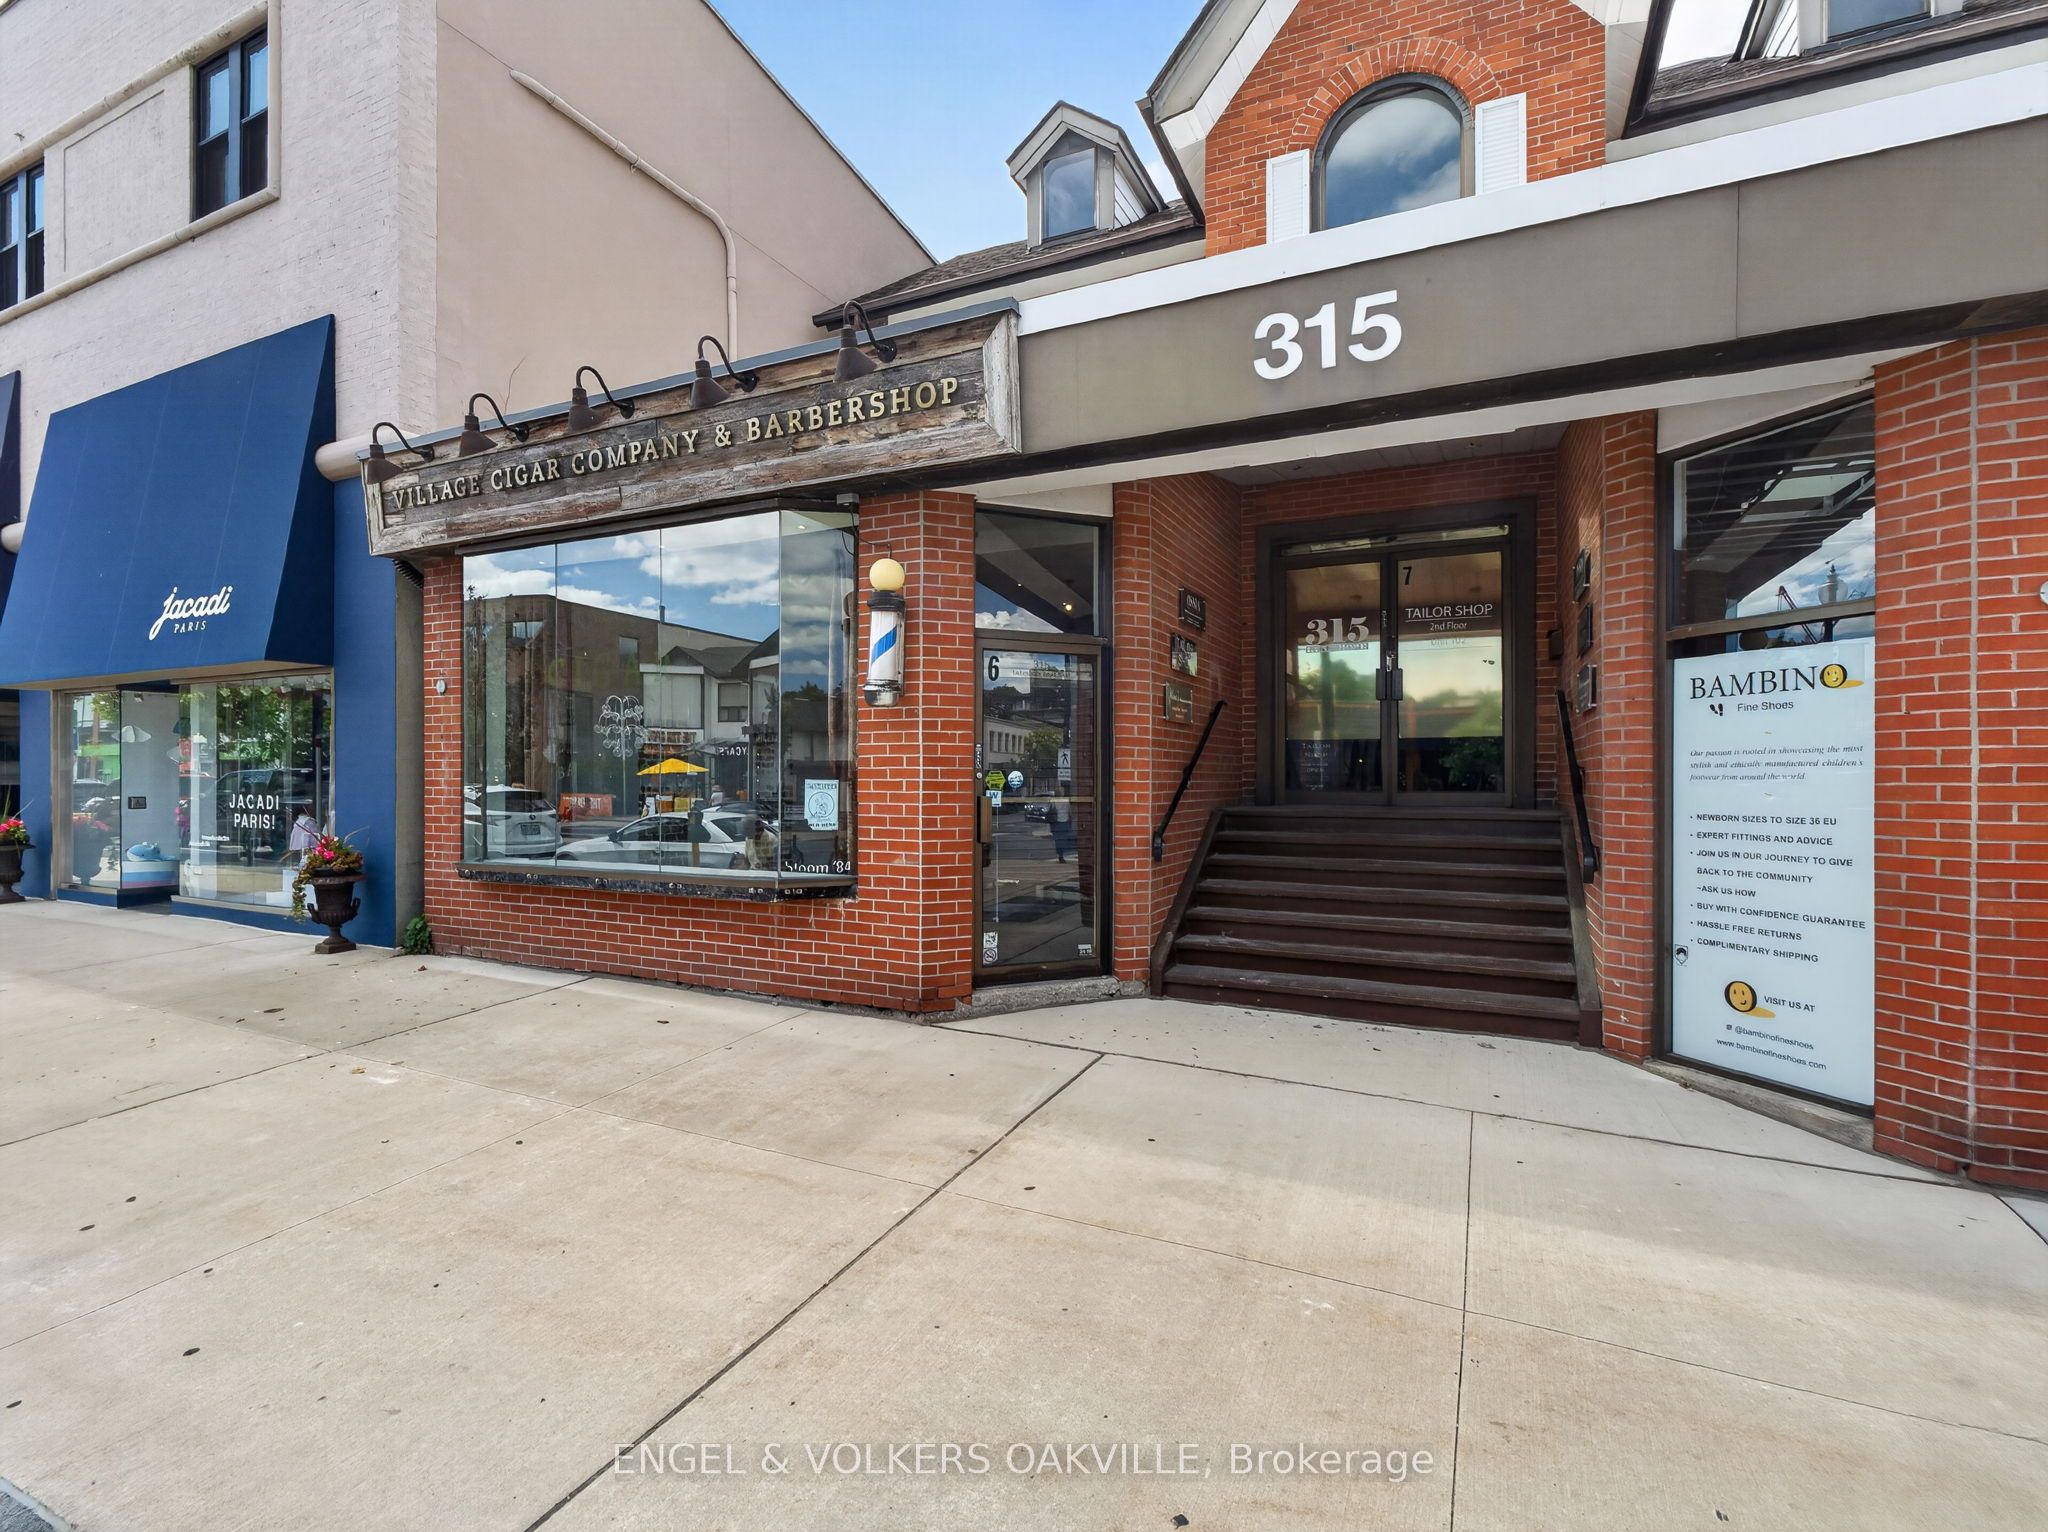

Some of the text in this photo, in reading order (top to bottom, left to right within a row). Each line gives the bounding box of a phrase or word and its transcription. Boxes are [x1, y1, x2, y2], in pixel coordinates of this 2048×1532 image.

[1254, 290, 1402, 380] 315
[391, 377, 959, 510] VILLAGE CIGAR COMPANY & BARBERSHOP
[1403, 567, 1412, 585] 7
[149, 585, 233, 640] jacadi
[1405, 603, 1493, 619] TAILOR SHOP
[173, 620, 207, 634] PARIS
[1305, 617, 1369, 645] 315
[1429, 621, 1468, 631] 2nd Floor
[988, 655, 1000, 681] 6
[1690, 663, 1847, 699] BAMBINO
[1738, 701, 1794, 712] Fine Shoes
[1706, 749, 1732, 757] passion
[1742, 747, 1766, 755] rooted
[1779, 746, 1824, 755] showcasing
[1764, 760, 1819, 768] manufactured
[1822, 759, 1863, 767] children's
[229, 793, 279, 810] JACADI
[233, 813, 275, 829] PARIS!
[1697, 814, 1739, 822] NEWBORN
[1697, 832, 1729, 840] EXPERT
[1732, 833, 1771, 842] FITTINGS
[1796, 837, 1833, 845] ADVICE
[1743, 852, 1762, 860] OUR
[1764, 854, 1809, 863] JOURNEY
[1813, 857, 1826, 865] TO
[1829, 858, 1853, 866] GIVE
[1697, 867, 1720, 875] BACK
[1756, 872, 1813, 883] COMMUNITY
[1735, 889, 1756, 897] HOW
[1716, 905, 1737, 913] WITH
[1740, 908, 1799, 920] CONFIDENCE
[1803, 914, 1865, 928] GUARANTEE
[1697, 920, 1802, 940] HASSLE FREE RETURNS
[1697, 938, 1819, 962] COMPLIMENTARY SHIPPING
[1764, 996, 1815, 1012] VISIT US AT
[1735, 1026, 1814, 1050] @bambinofineshoes
[1717, 1039, 1826, 1070] www.bambinofineshoes.com
